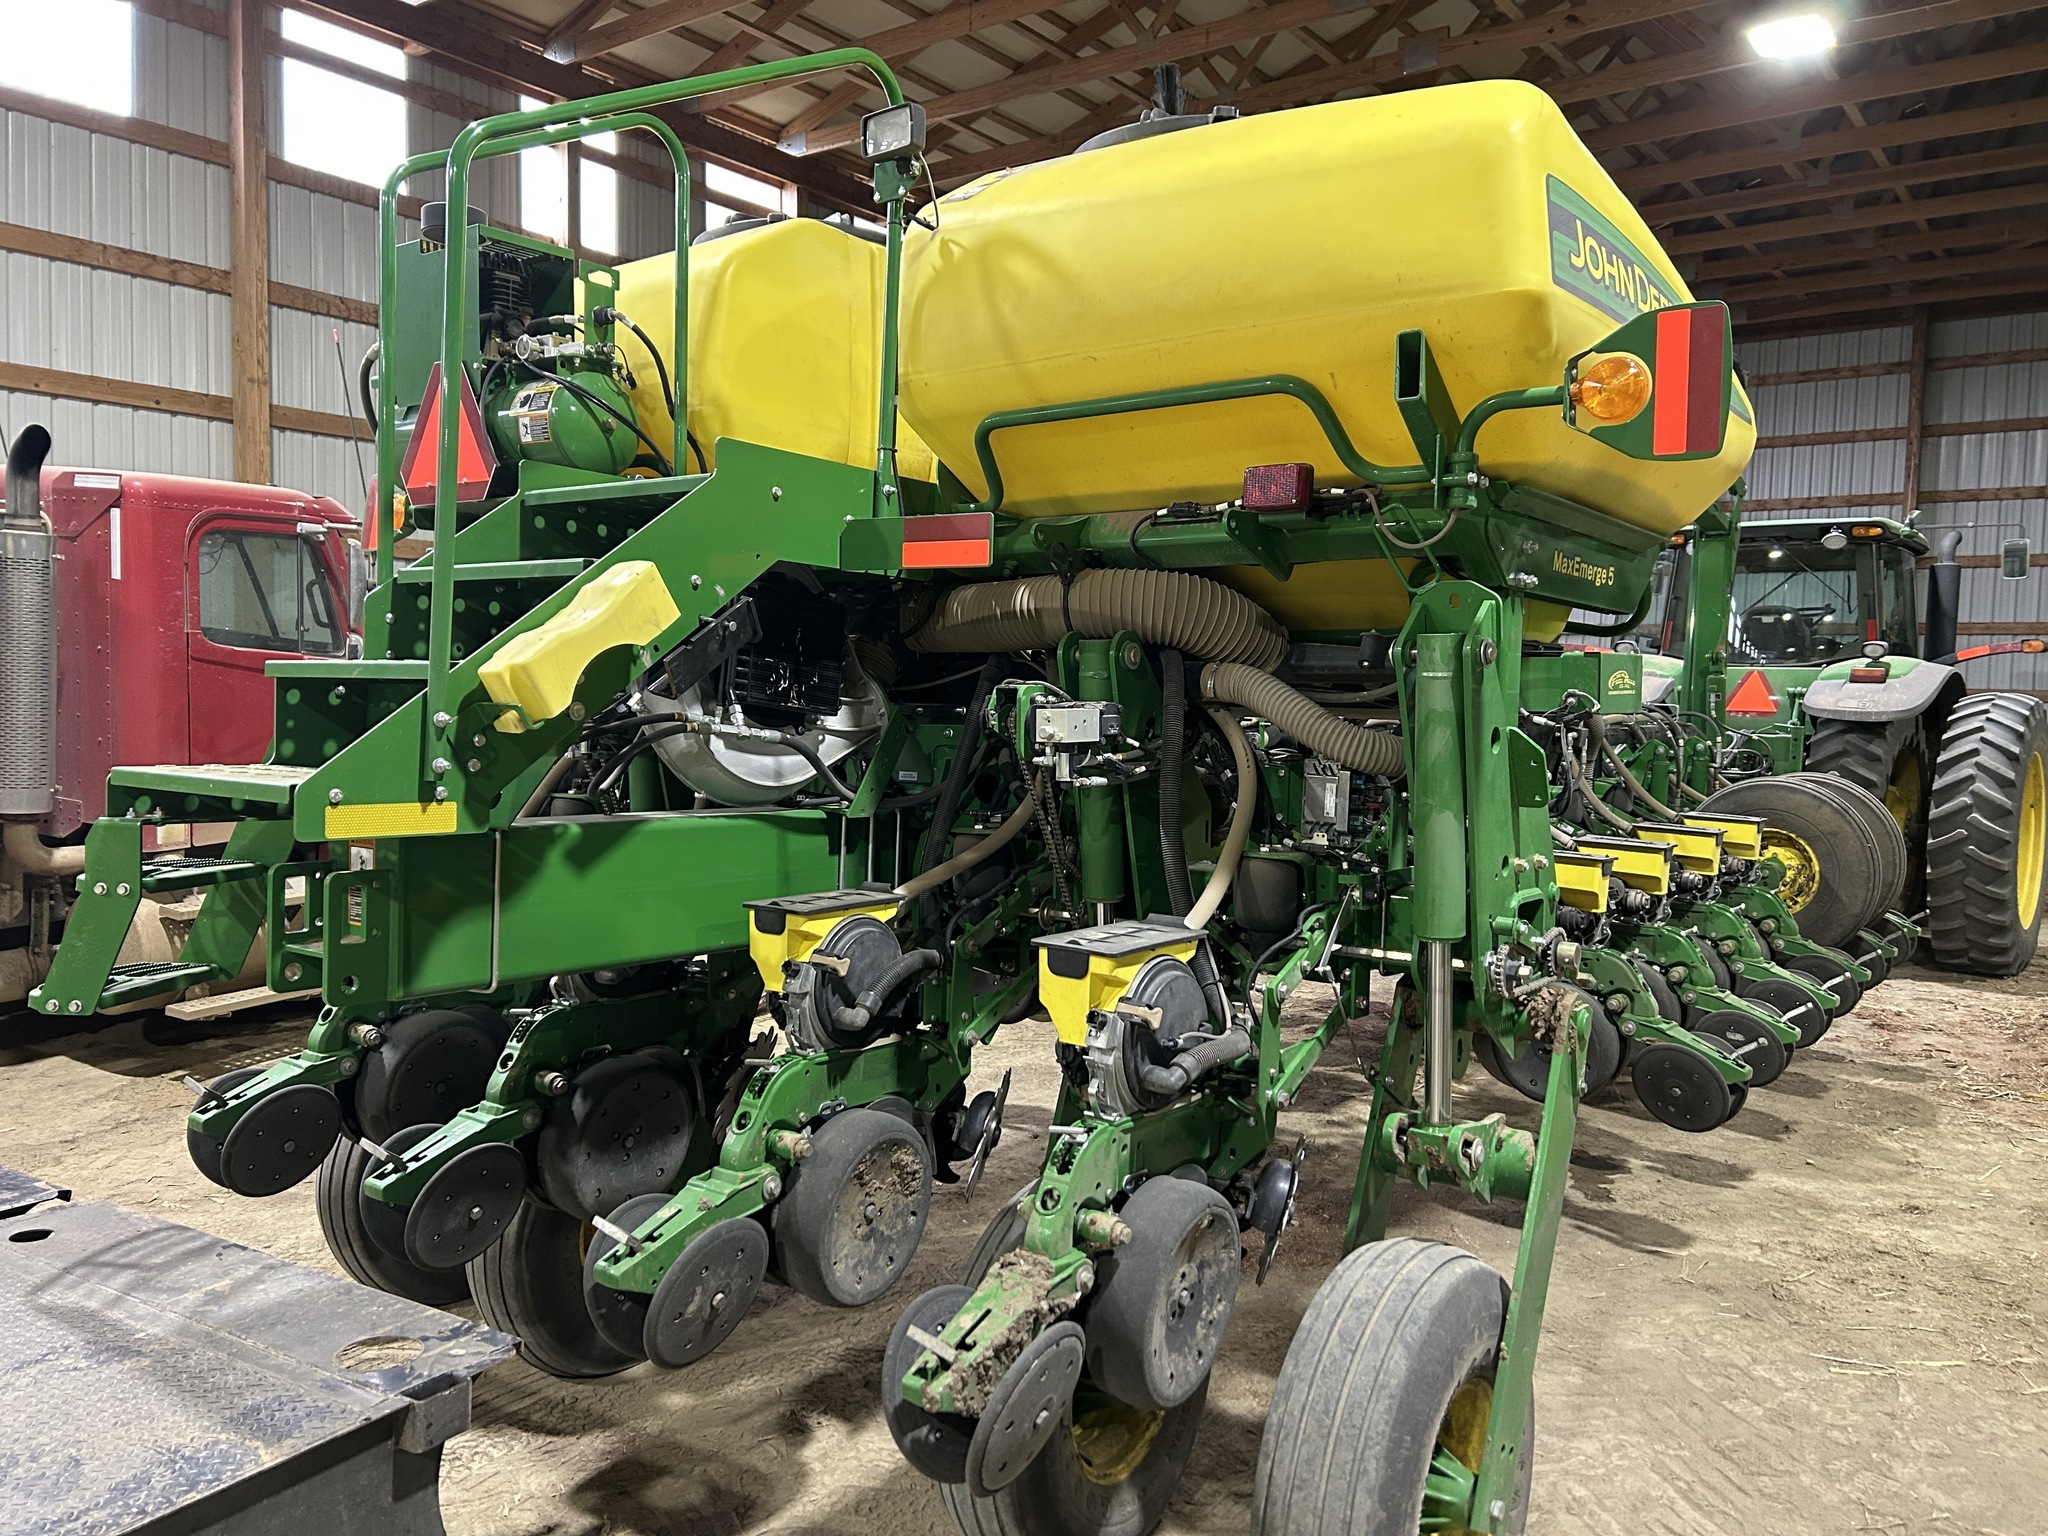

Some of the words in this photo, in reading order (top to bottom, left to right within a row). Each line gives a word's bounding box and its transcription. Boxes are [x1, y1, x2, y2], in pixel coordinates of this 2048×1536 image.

[1570, 219, 1635, 303] JOHN
[1553, 550, 1607, 587] MaxEmerge
[1608, 566, 1615, 586] 5
